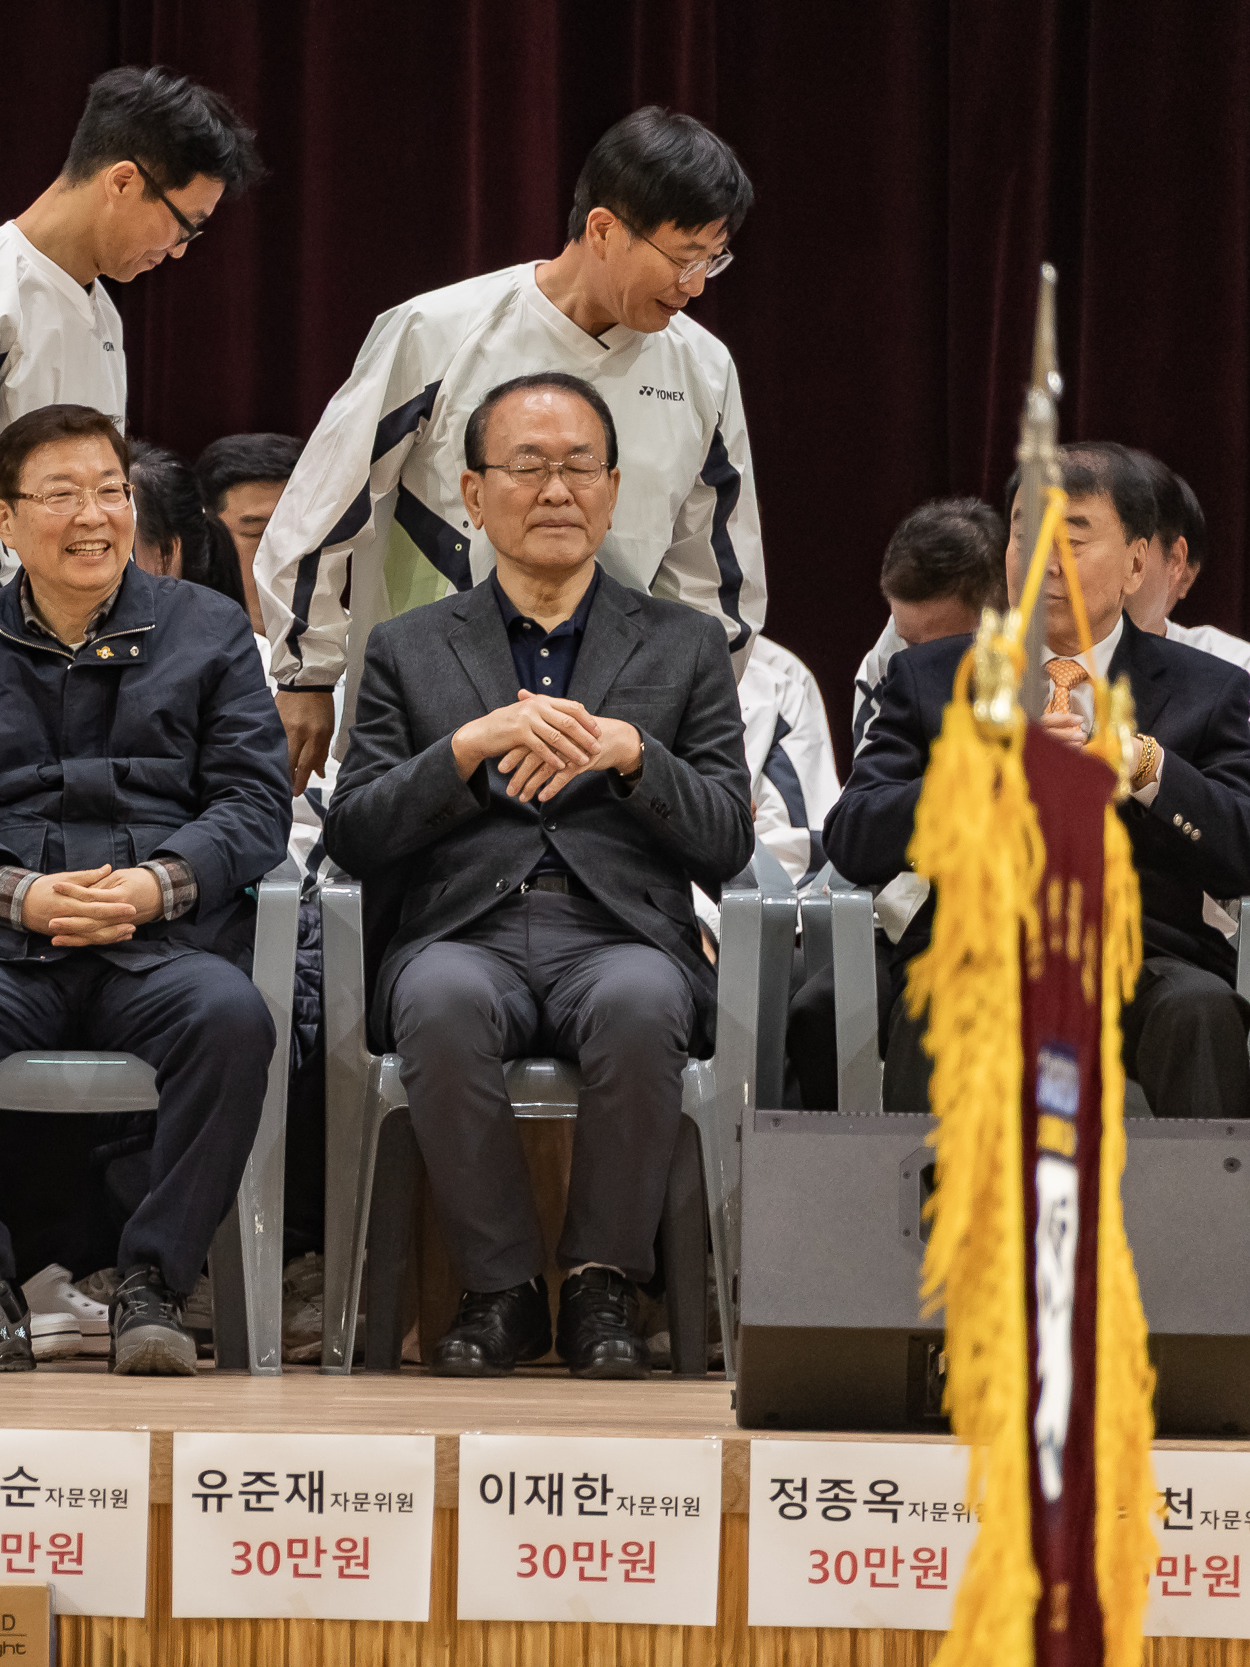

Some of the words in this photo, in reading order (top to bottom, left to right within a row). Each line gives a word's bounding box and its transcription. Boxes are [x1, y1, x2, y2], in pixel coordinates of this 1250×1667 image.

[655, 388, 685, 402] YONEX
[45, 1487, 128, 1509] 자문위원
[191, 1469, 324, 1515] 유준재
[329, 1491, 413, 1513] 자문위원
[479, 1471, 614, 1517] 이재한
[616, 1495, 700, 1517] 자문위원
[769, 1477, 905, 1524] 정종옥
[231, 1535, 370, 1580] 30만원
[516, 1539, 656, 1584] 30만원
[808, 1545, 948, 1590] 30만원
